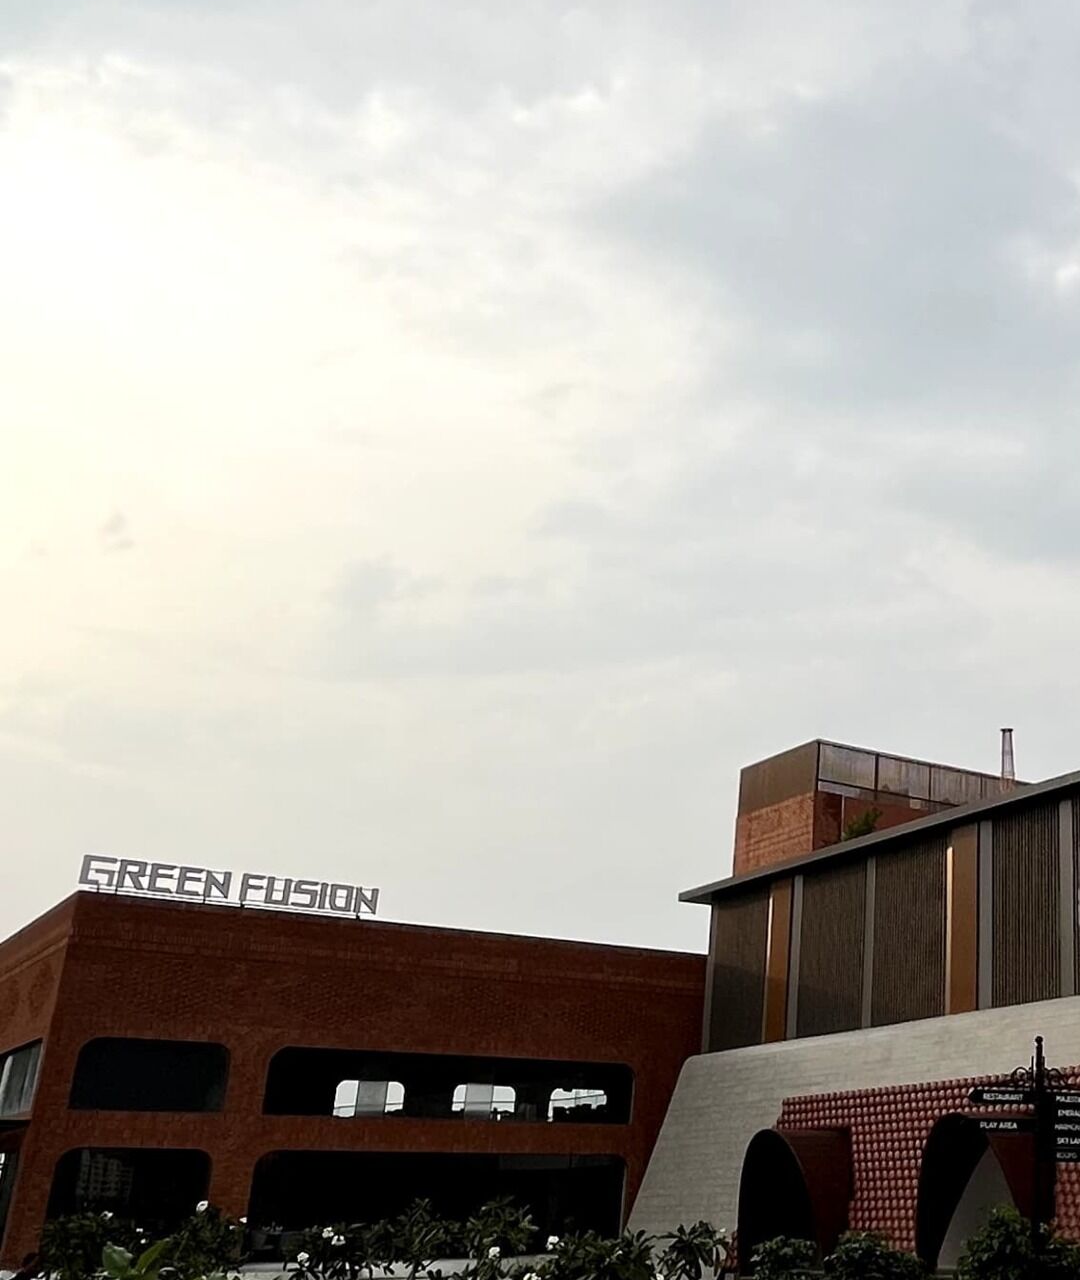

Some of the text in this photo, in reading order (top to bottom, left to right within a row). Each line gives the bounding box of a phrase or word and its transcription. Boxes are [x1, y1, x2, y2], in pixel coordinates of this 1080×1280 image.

[78, 854, 379, 915] GREEN FUSION
[982, 1093, 1024, 1102] RESTAURANT
[979, 1121, 1018, 1130] PLAY AREA
